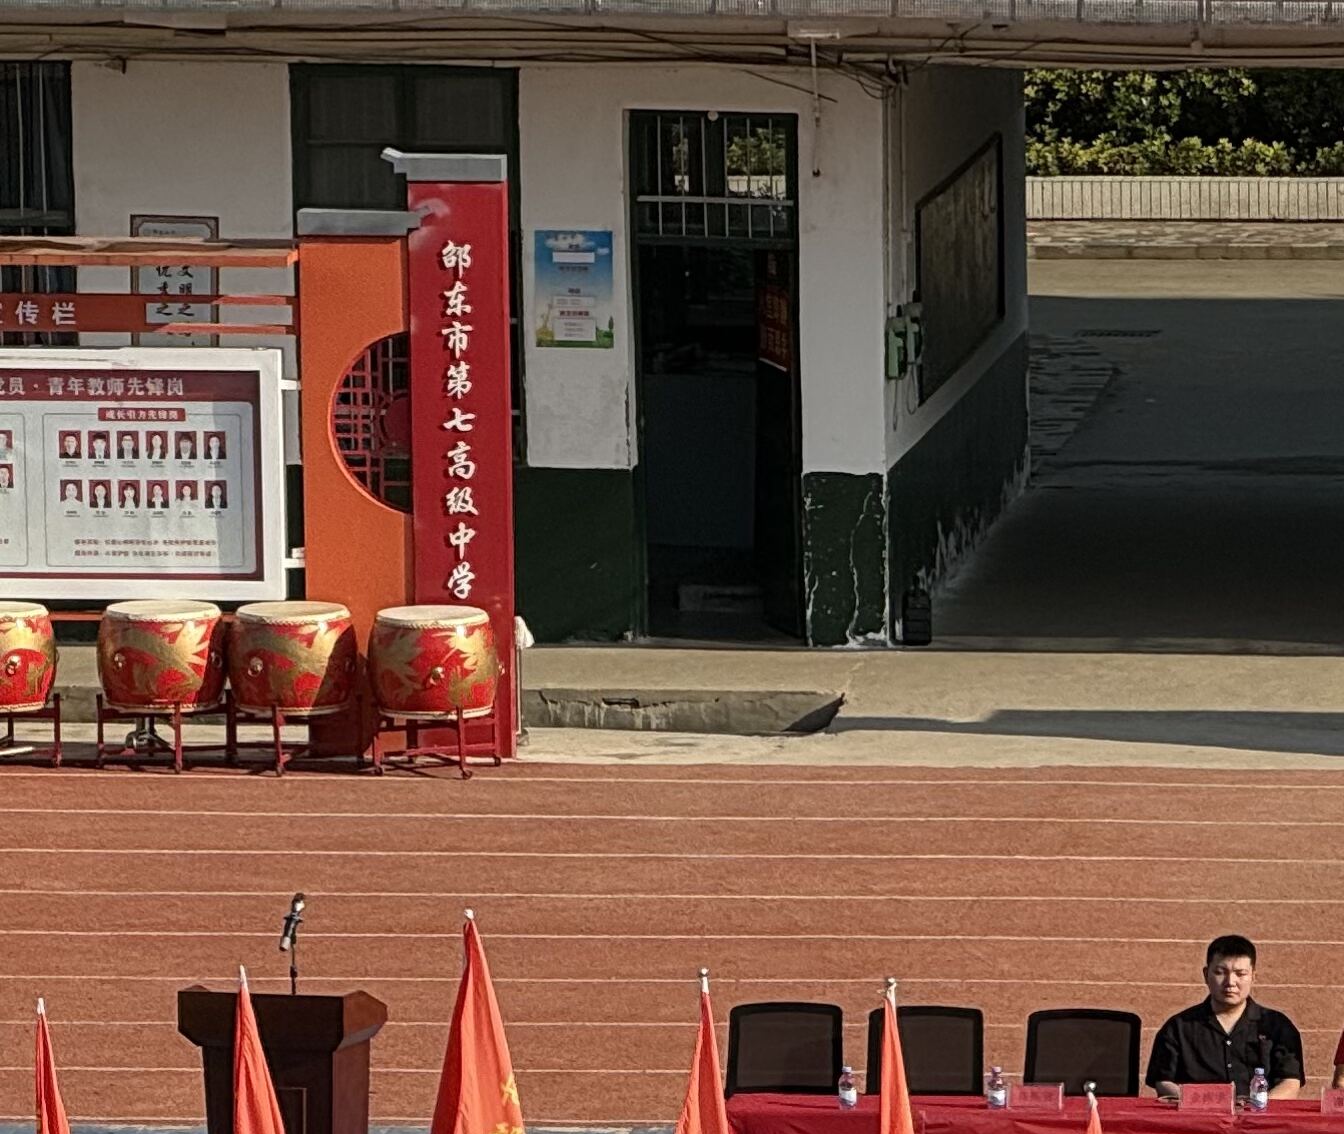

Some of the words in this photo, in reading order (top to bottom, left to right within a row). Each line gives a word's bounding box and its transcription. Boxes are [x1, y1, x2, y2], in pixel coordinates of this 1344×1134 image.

[0, 301, 77, 325] 传栏
[440, 239, 479, 599] 邵东市第七高级中学
